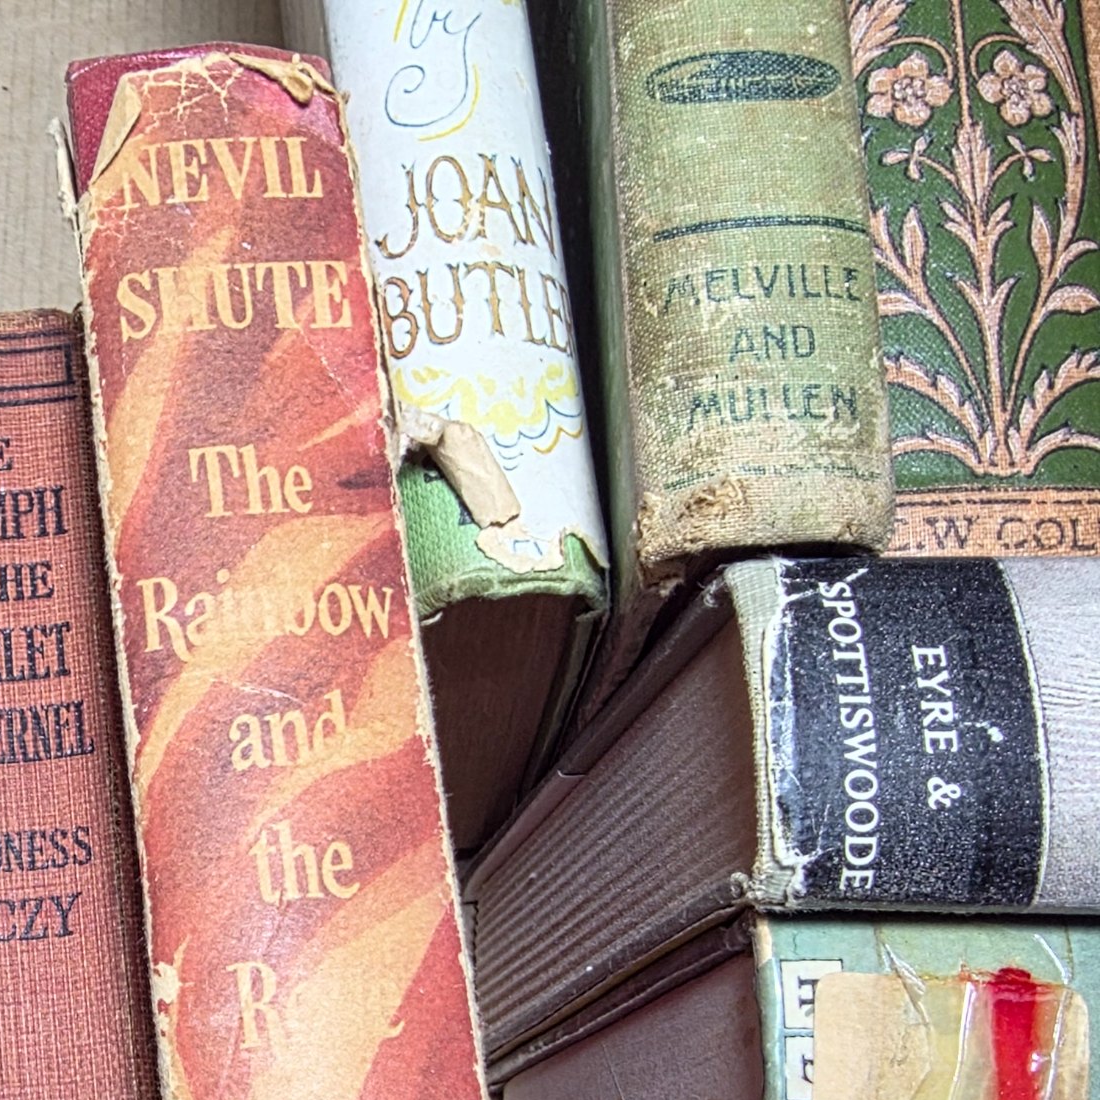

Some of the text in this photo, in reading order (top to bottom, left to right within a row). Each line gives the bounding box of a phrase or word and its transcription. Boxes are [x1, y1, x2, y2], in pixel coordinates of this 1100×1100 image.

[116, 134, 324, 212] NEVIL
[374, 152, 556, 260] JOAN
[116, 259, 353, 343] SHUTE
[662, 262, 863, 318] MELVILLE
[727, 323, 816, 363] AND
[686, 380, 862, 433] MULLEN
[188, 443, 315, 519] The
[996, 514, 1100, 553] COL
[135, 567, 395, 664] Rabow
[228, 689, 351, 772] and
[818, 578, 880, 891] SPOTTISWOODE
[911, 644, 963, 810] EYRE &
[247, 820, 362, 908] the
